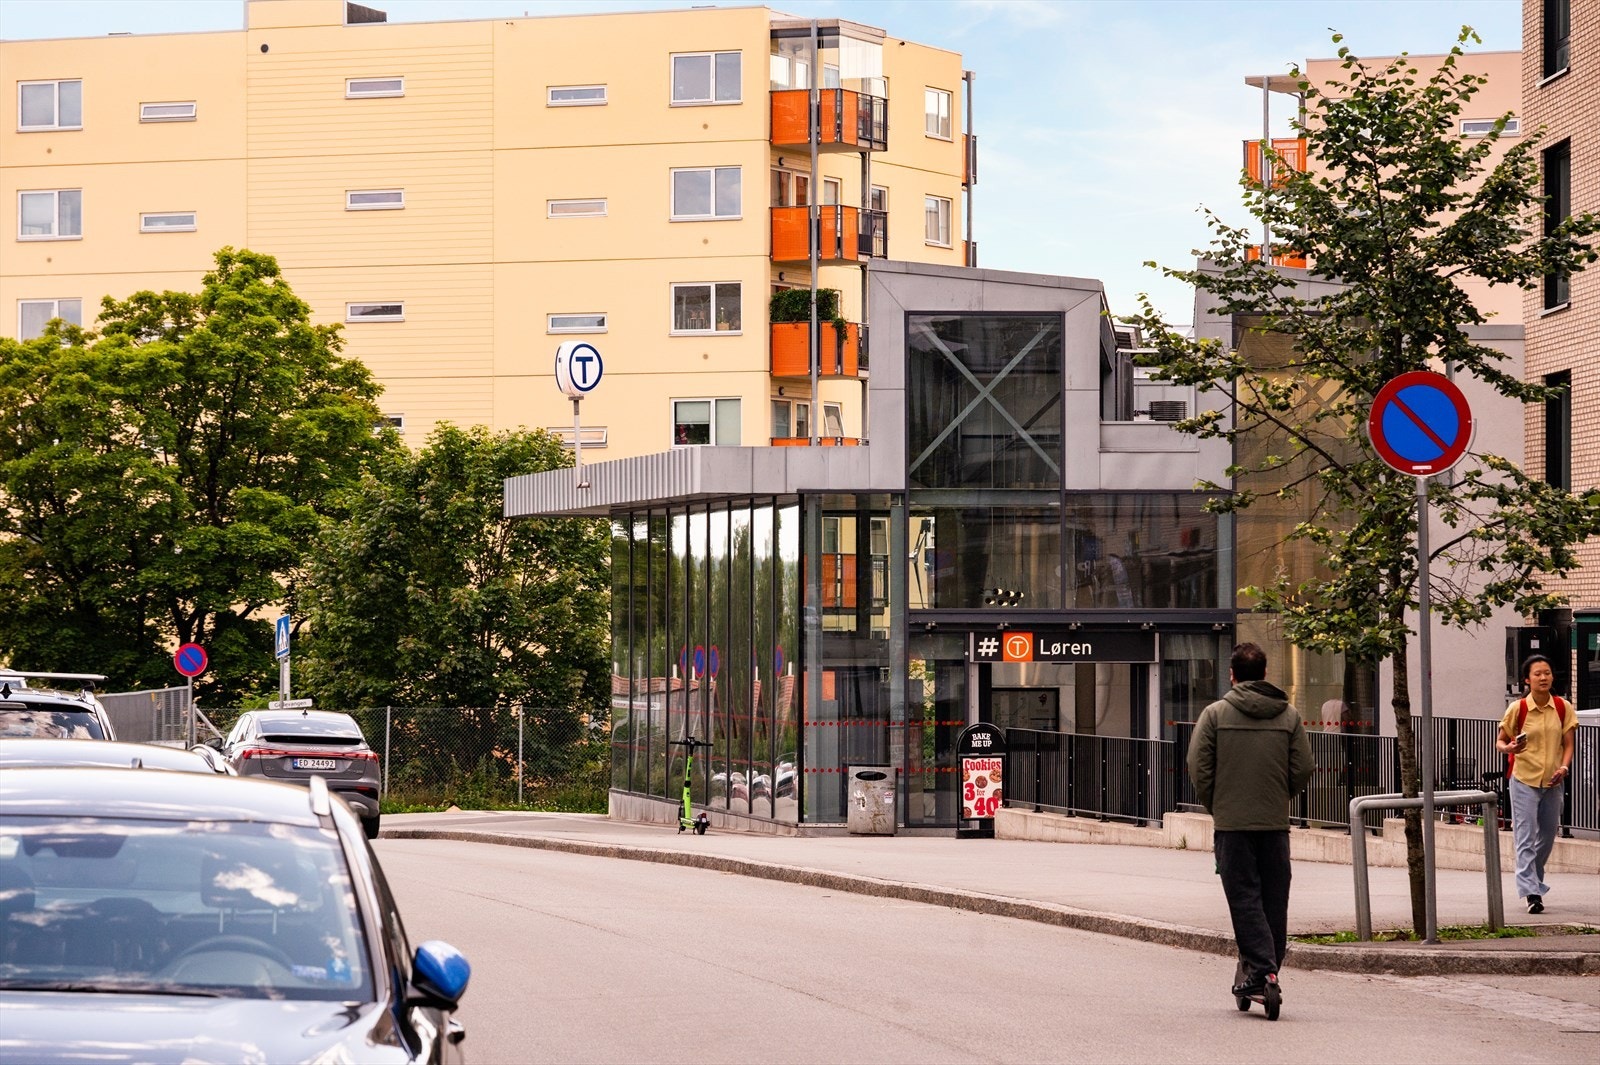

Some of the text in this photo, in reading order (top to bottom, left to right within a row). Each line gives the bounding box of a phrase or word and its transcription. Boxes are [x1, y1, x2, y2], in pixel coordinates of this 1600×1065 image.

[575, 356, 593, 384] T
[1040, 639, 1092, 656] Løren
[964, 759, 1001, 771] Cookies
[965, 782, 975, 801] 3
